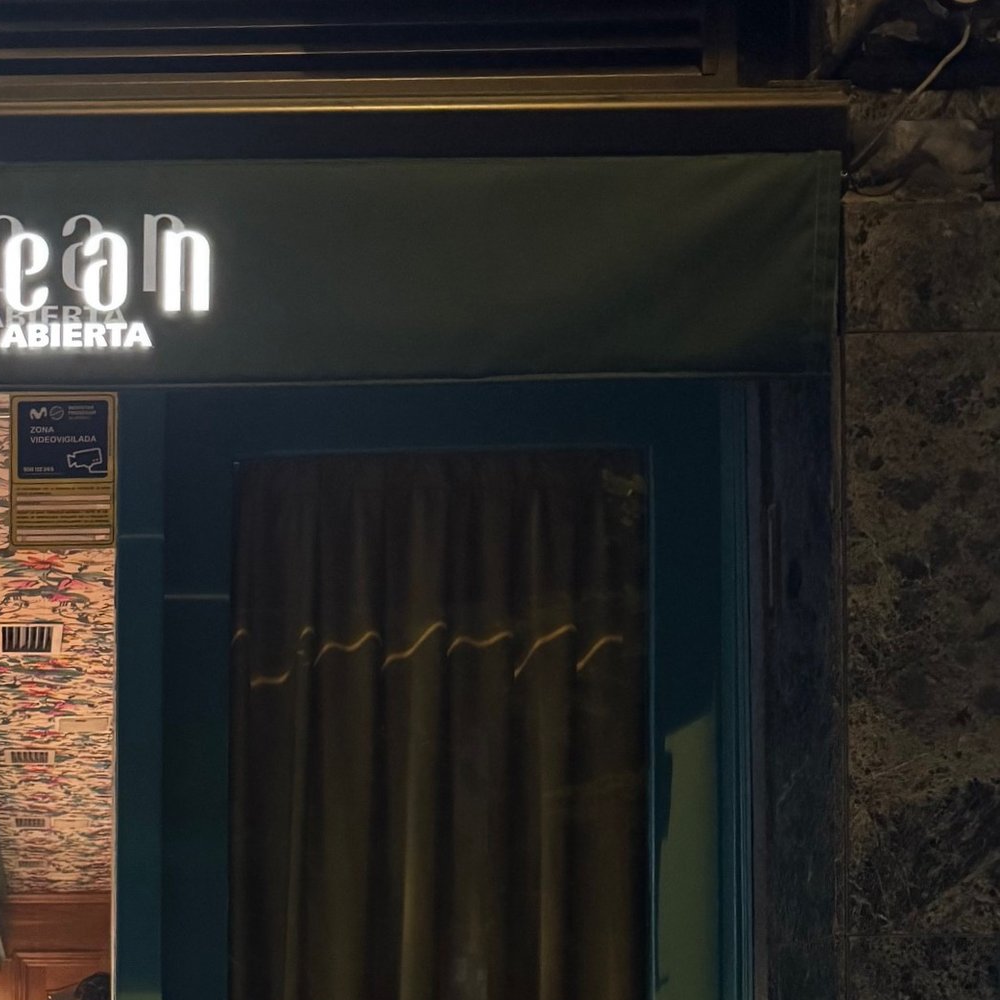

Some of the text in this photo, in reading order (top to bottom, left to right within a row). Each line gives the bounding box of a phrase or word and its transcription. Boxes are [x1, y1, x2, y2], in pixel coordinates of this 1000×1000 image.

[0, 322, 153, 348] ABIERTA
[30, 426, 55, 434] ZONA
[30, 435, 97, 444] VIDEOVIGILADA
